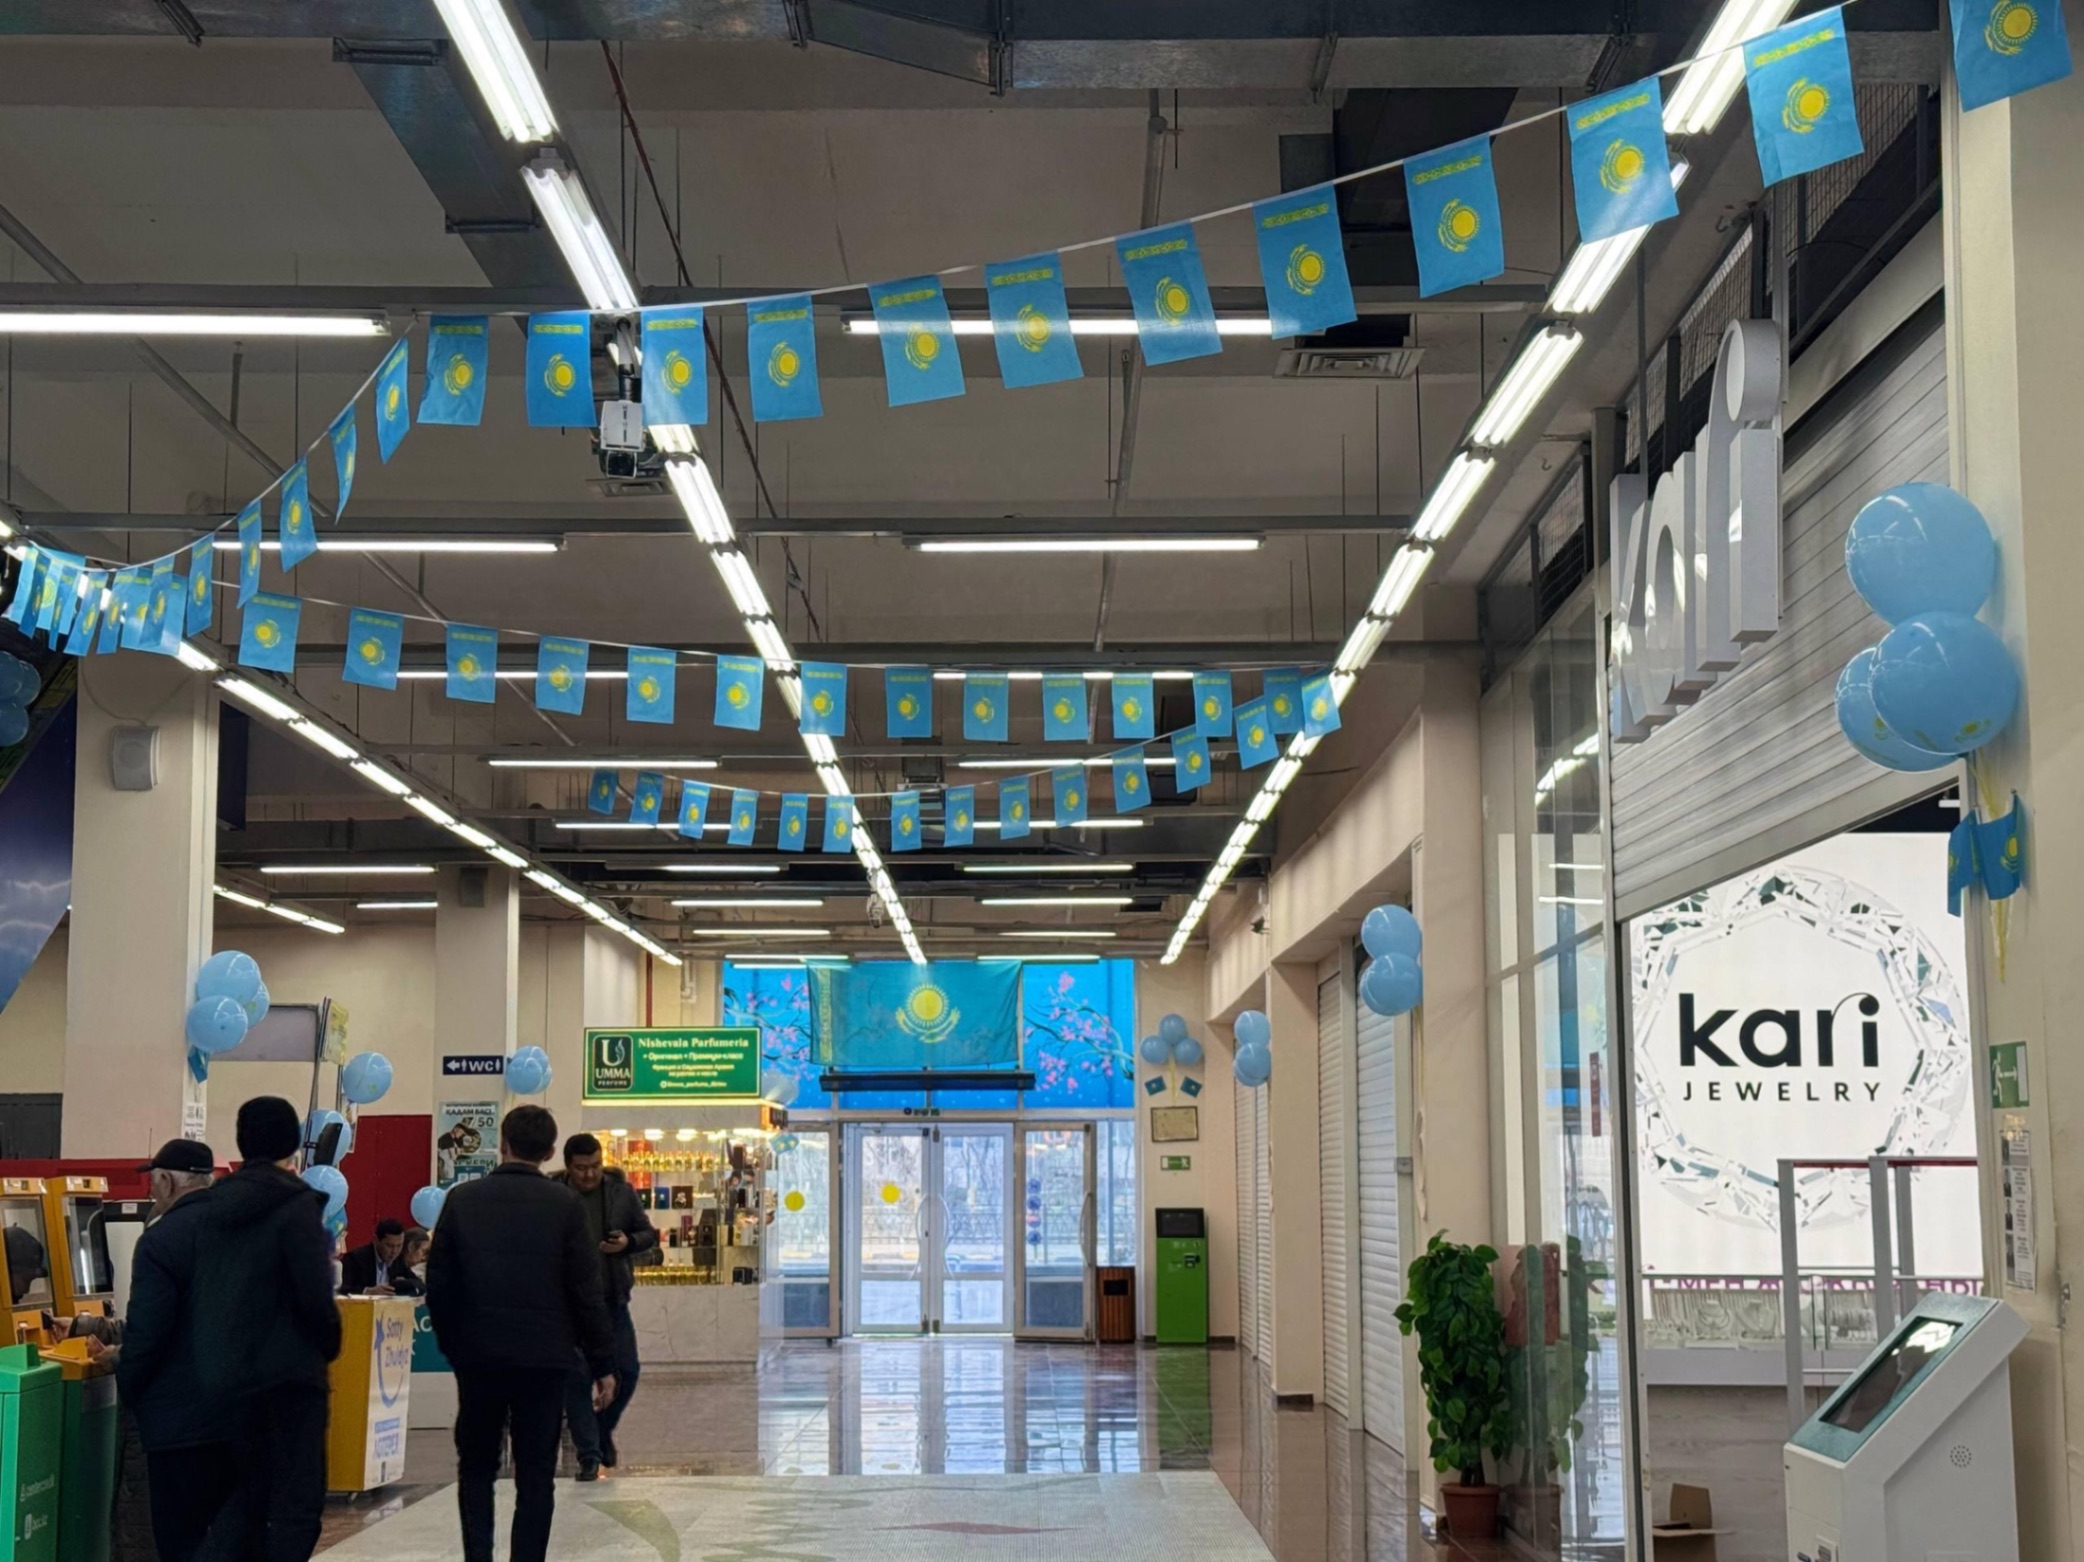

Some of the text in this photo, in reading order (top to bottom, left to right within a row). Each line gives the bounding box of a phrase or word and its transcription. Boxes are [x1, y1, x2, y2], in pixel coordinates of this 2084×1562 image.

[1679, 992, 1880, 1068] kari
[691, 1037, 749, 1048] Parfumeria
[468, 1060, 494, 1072] WC
[595, 1068, 631, 1079] UMMA
[1683, 1081, 1880, 1101] JEWELRY
